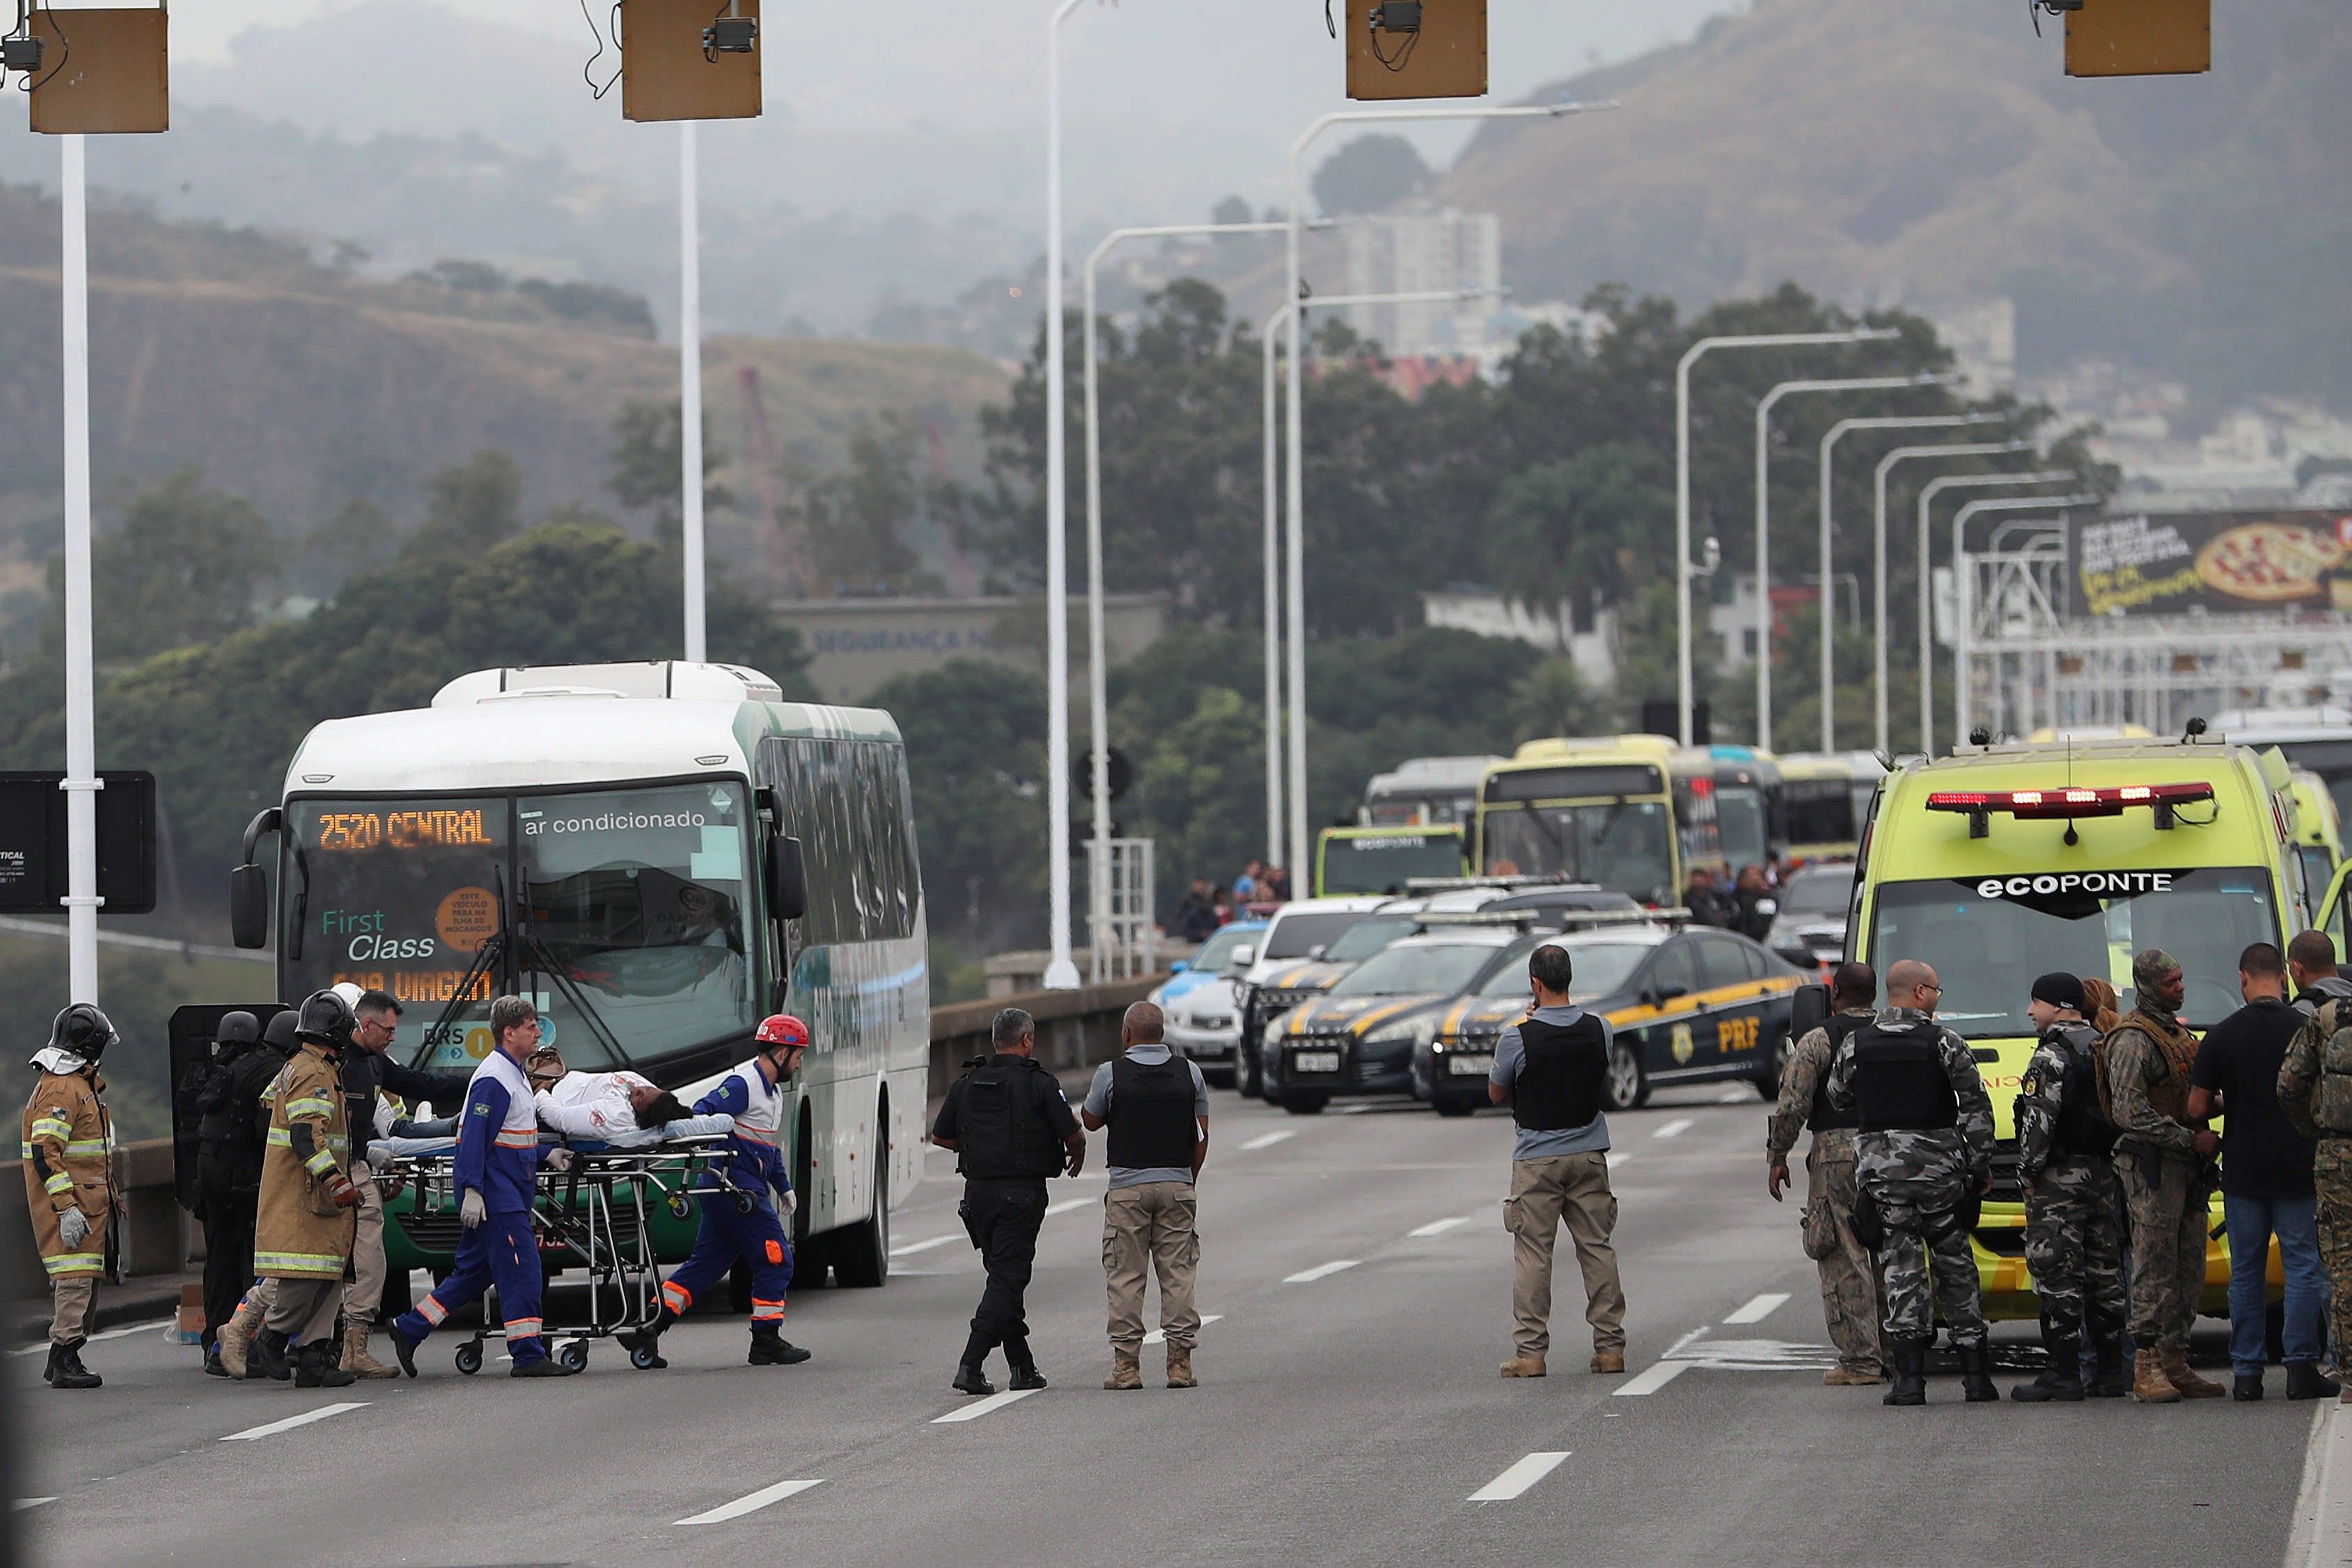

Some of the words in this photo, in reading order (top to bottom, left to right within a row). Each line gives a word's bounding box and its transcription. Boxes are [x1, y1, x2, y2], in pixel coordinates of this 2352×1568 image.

[320, 813, 381, 849] 2520
[387, 810, 492, 847] CENTRAL
[525, 820, 547, 835] ar
[552, 810, 705, 833] condicionado
[322, 909, 385, 935] First
[348, 934, 435, 962] Class
[1717, 1015, 1761, 1054] PRF
